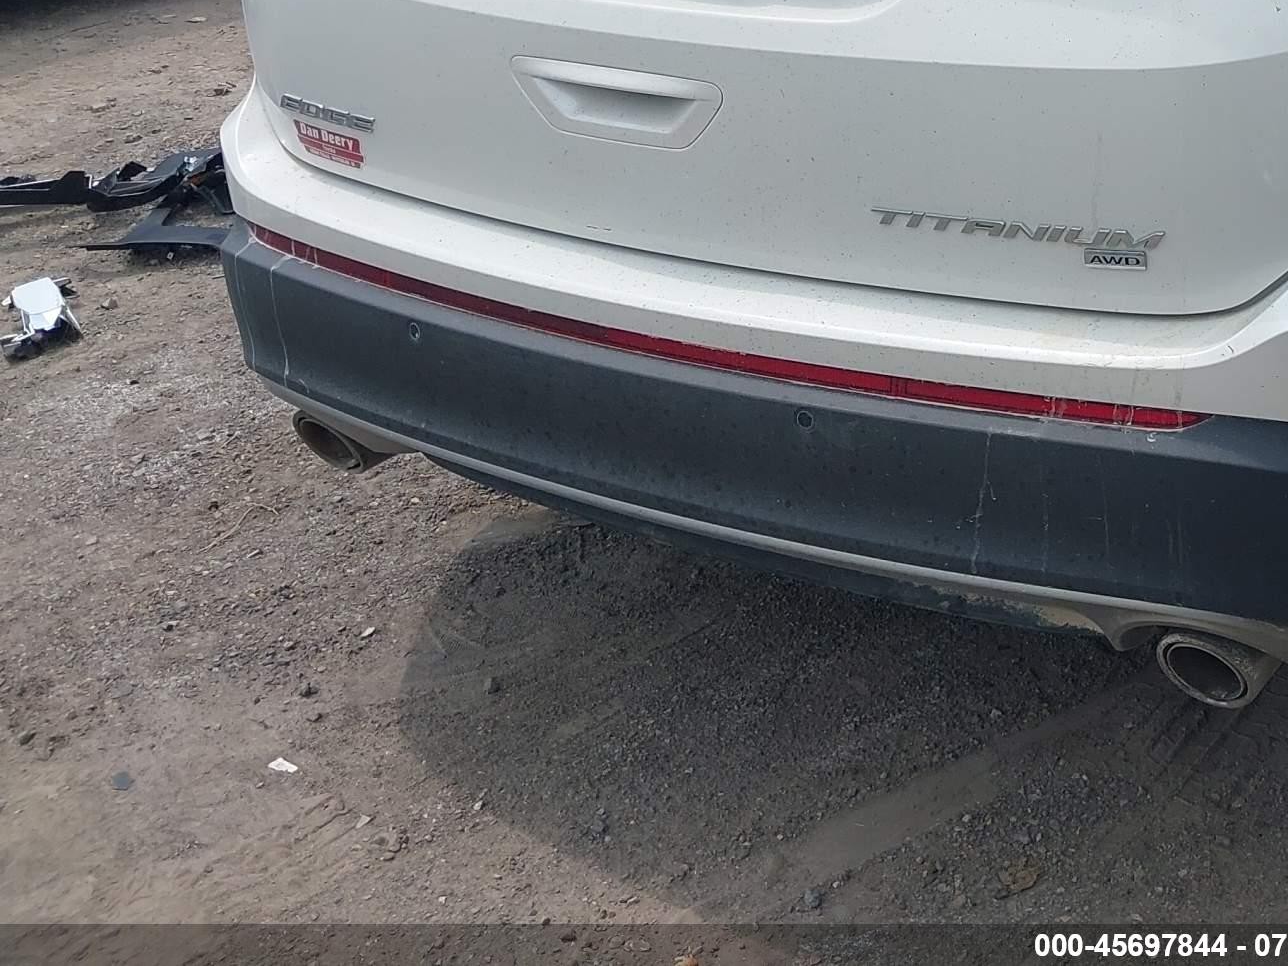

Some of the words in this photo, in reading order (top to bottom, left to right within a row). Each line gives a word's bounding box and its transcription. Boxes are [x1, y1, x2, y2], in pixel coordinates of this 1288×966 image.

[280, 93, 376, 134] EDGE
[299, 121, 319, 139] Dan
[321, 129, 354, 152] Deery
[871, 206, 1166, 250] TITANIUM
[1089, 254, 1141, 266] AWD
